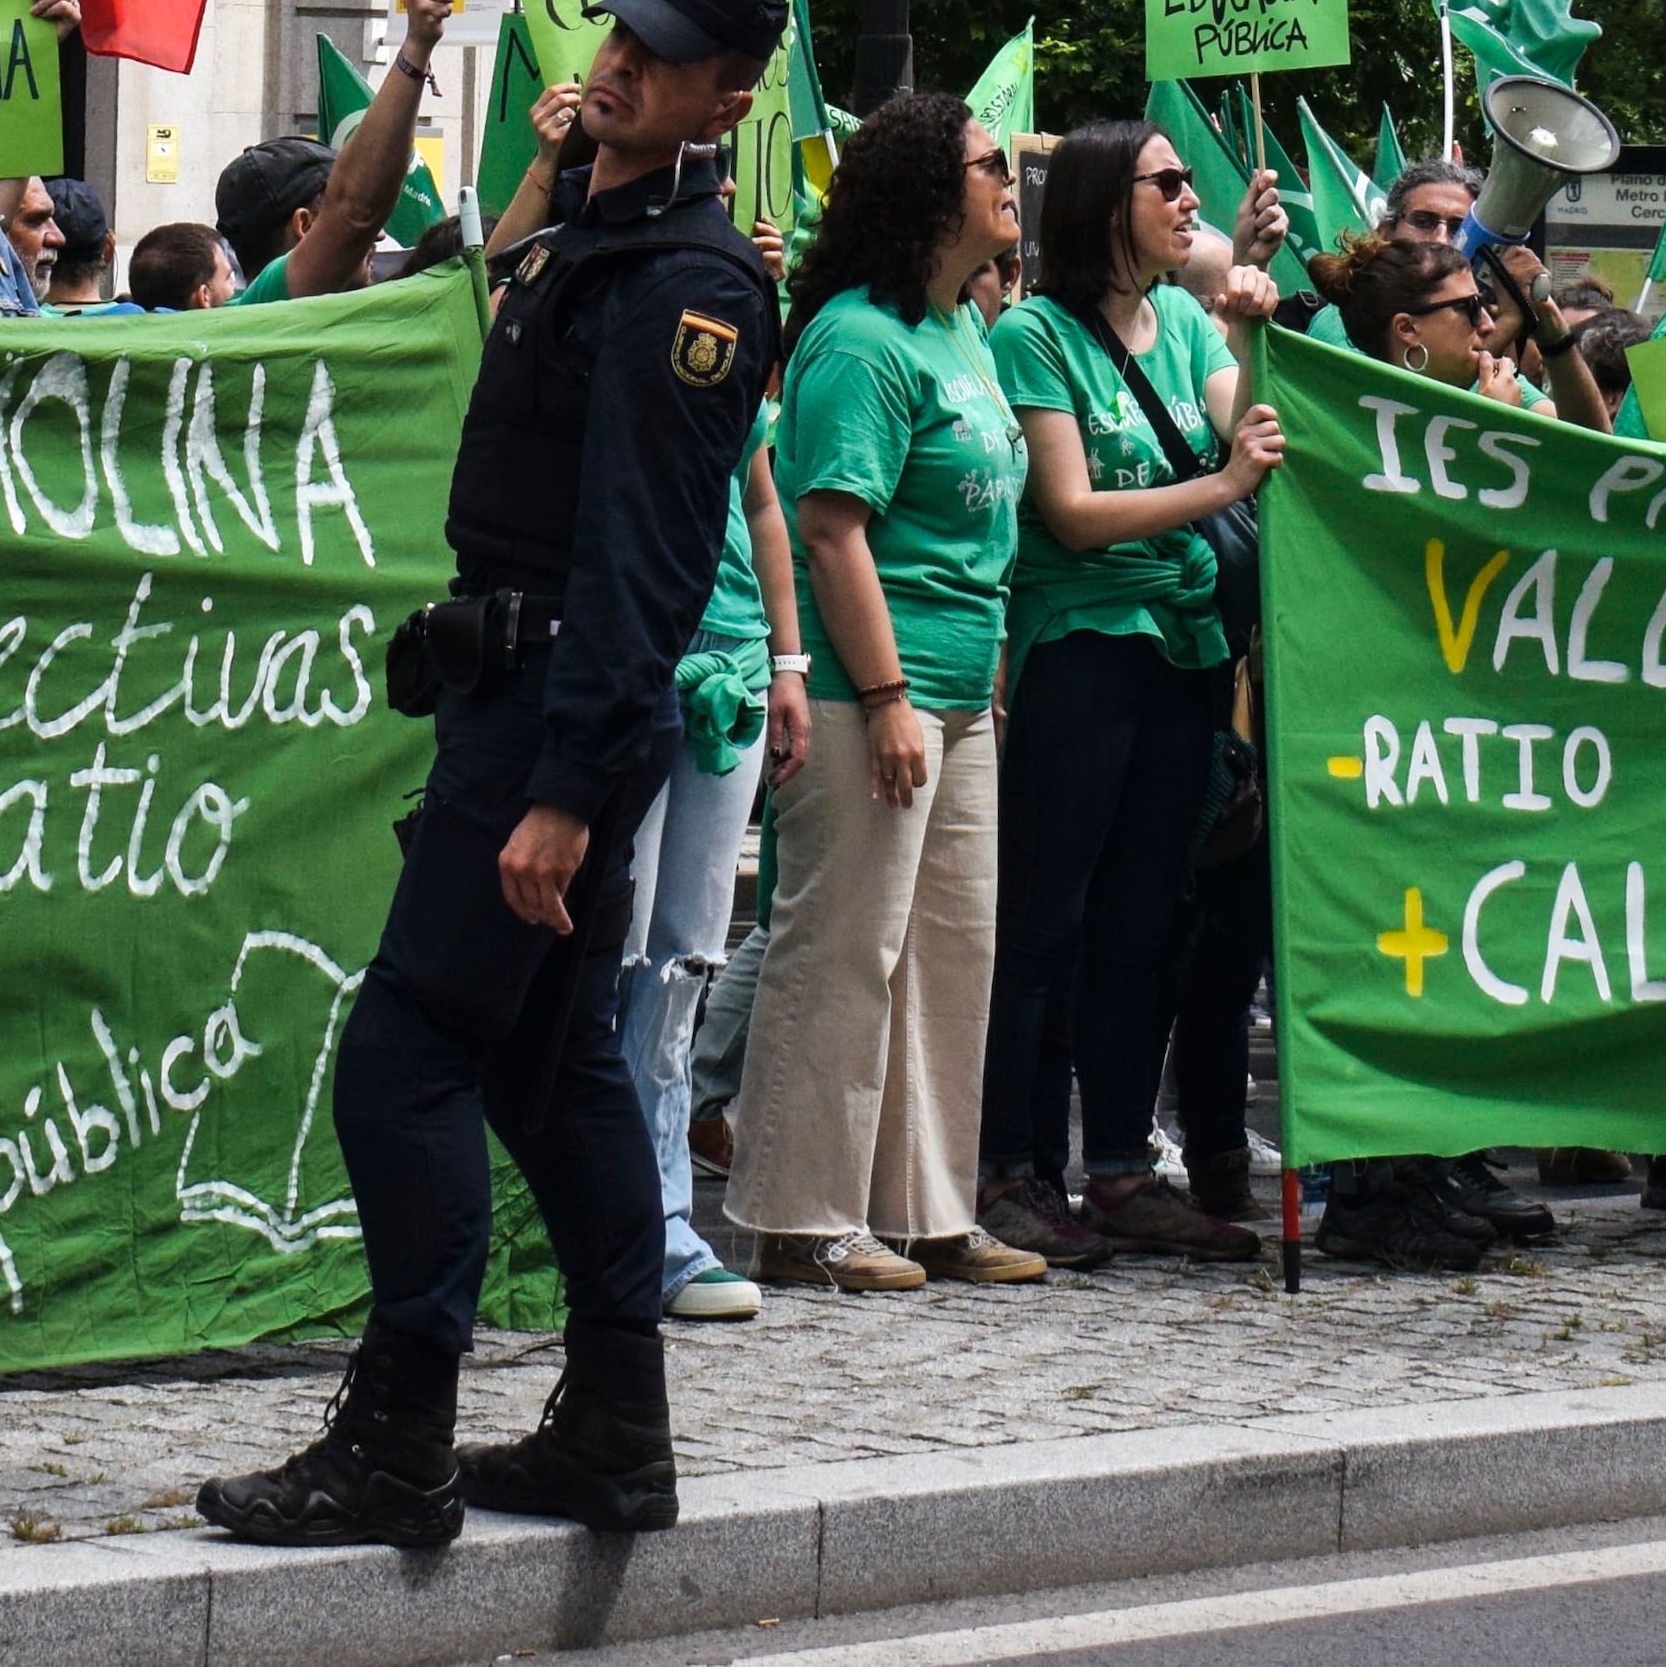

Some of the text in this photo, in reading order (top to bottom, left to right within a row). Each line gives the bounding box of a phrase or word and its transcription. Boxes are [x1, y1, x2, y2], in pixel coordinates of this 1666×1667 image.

[1193, 18, 1309, 65] PÚBLICA
[1611, 173, 1653, 186] Plano
[1615, 190, 1658, 203] Metro
[1357, 394, 1541, 511] IES
[1115, 460, 1151, 489] DE
